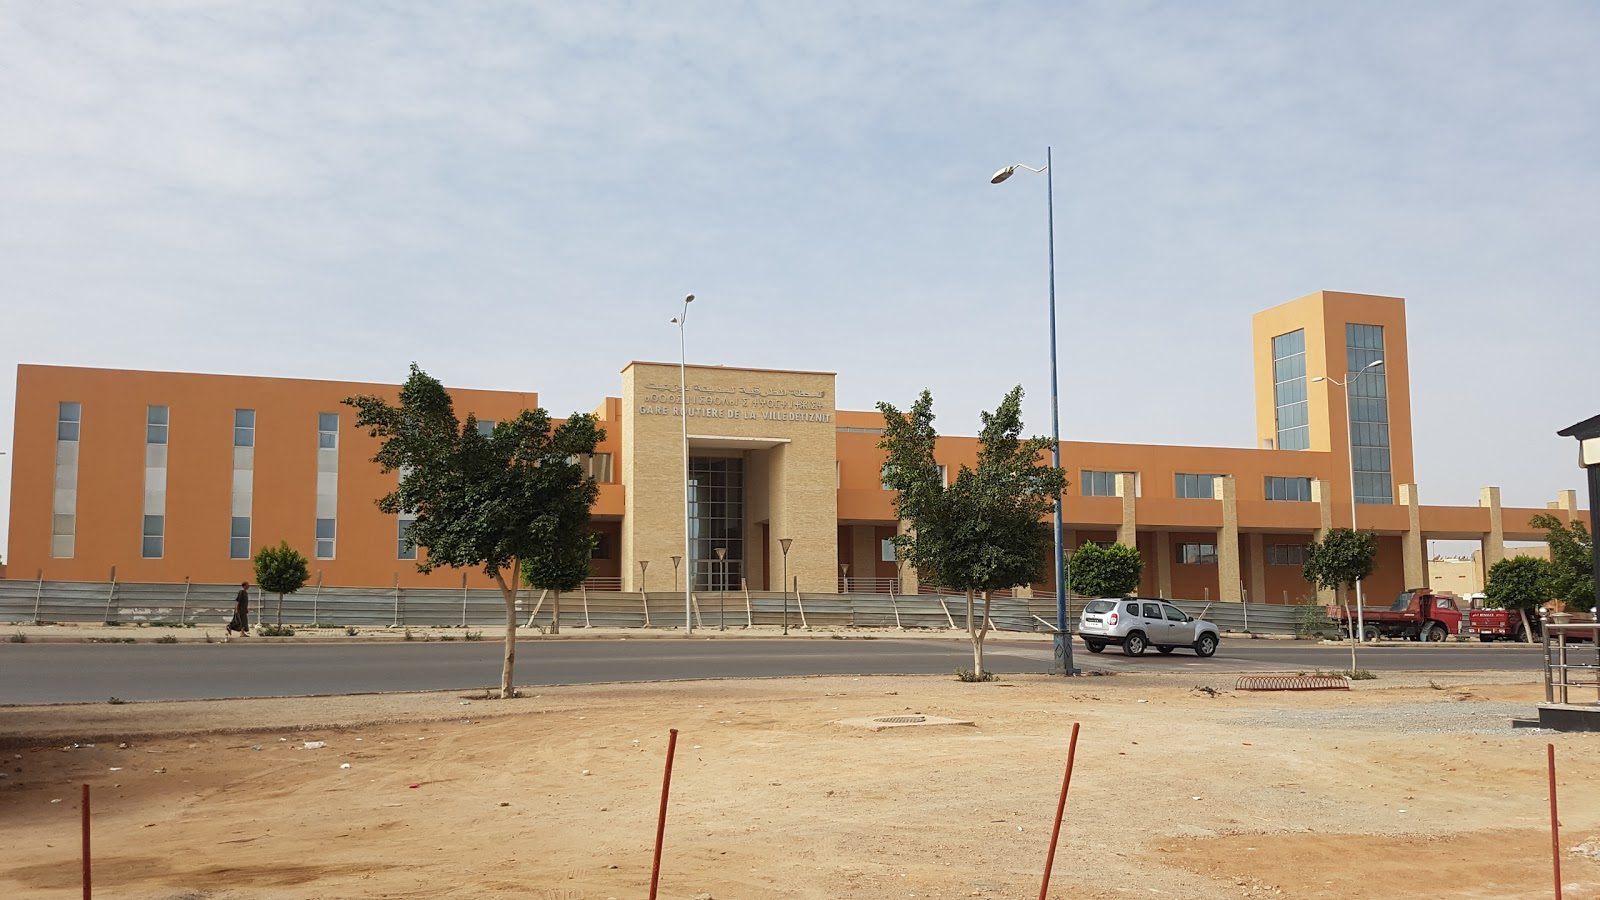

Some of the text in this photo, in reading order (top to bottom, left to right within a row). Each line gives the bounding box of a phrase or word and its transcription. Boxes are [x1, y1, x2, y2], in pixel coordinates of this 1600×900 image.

[640, 405, 669, 416] GARE
[673, 407, 725, 418] ROUTIERE
[727, 410, 740, 420] DE
[744, 411, 756, 420] LA
[762, 411, 787, 421] VILLE
